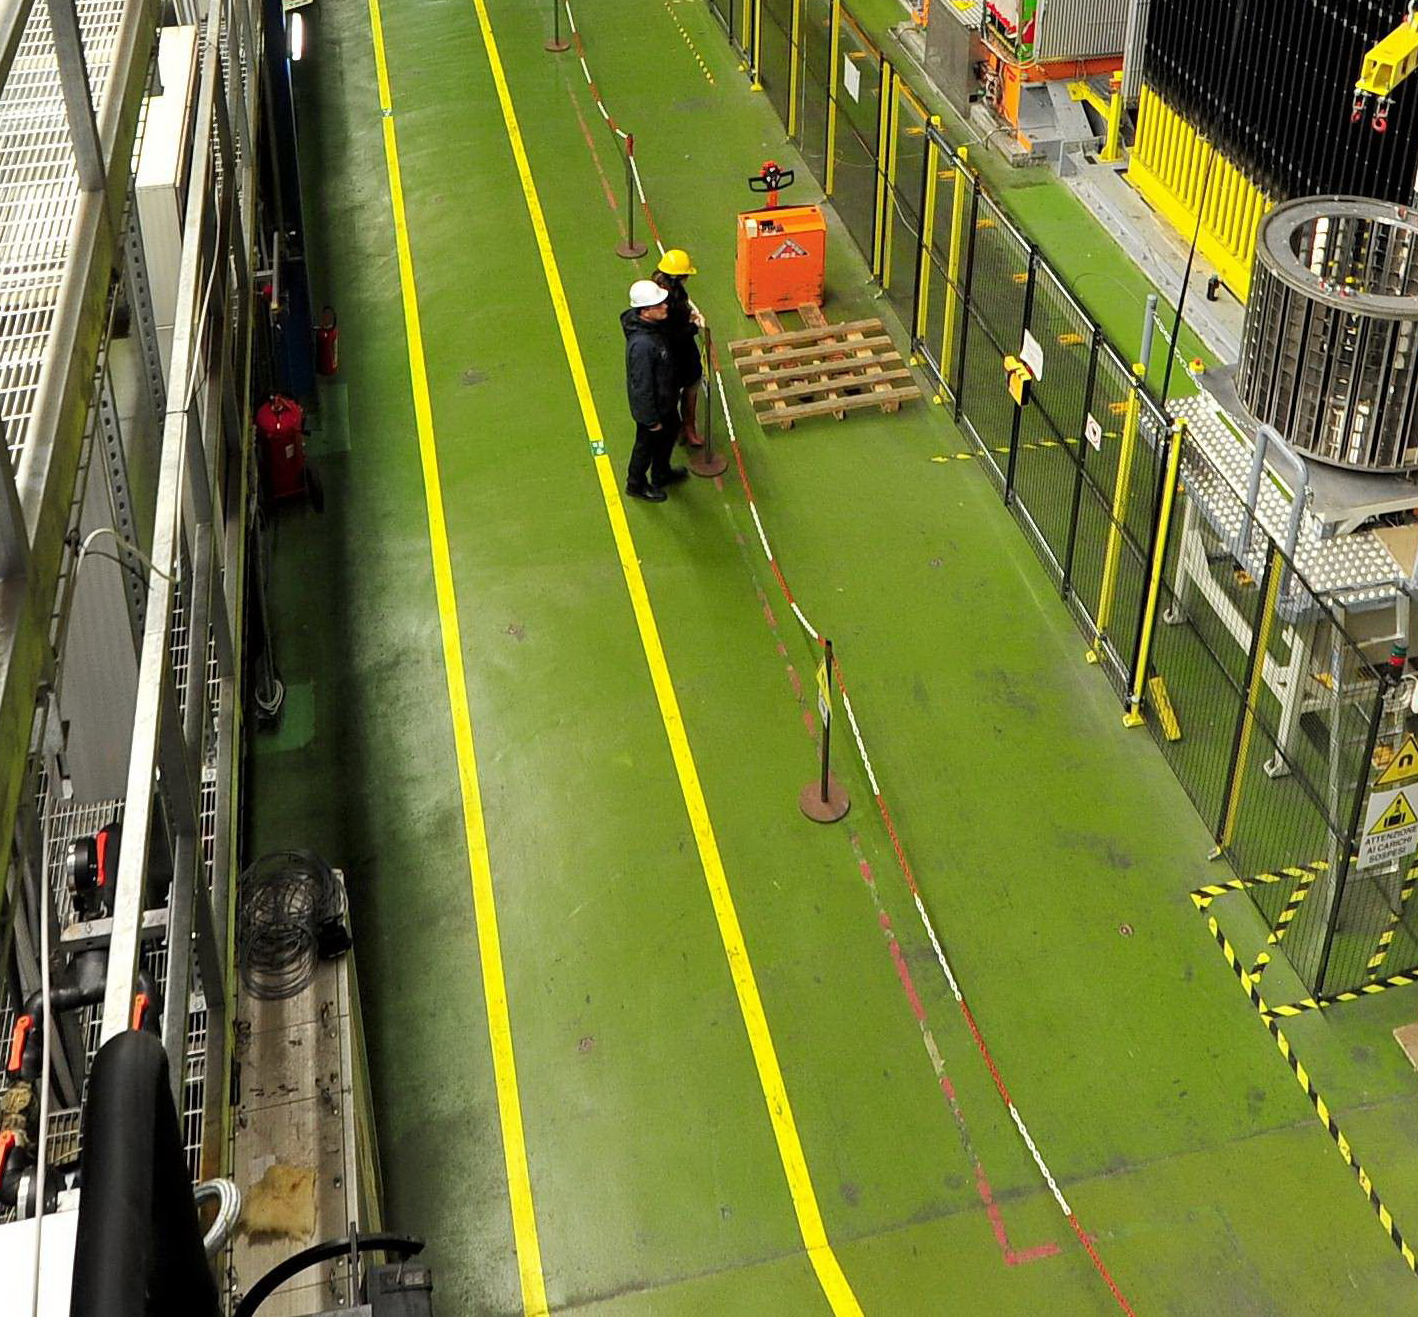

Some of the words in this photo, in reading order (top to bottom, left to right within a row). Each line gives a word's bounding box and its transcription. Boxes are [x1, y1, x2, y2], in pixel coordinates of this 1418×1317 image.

[1366, 825, 1417, 844] ATTENZIONE
[1377, 836, 1413, 851] CARICHI
[1369, 847, 1406, 863] SOSPESI
